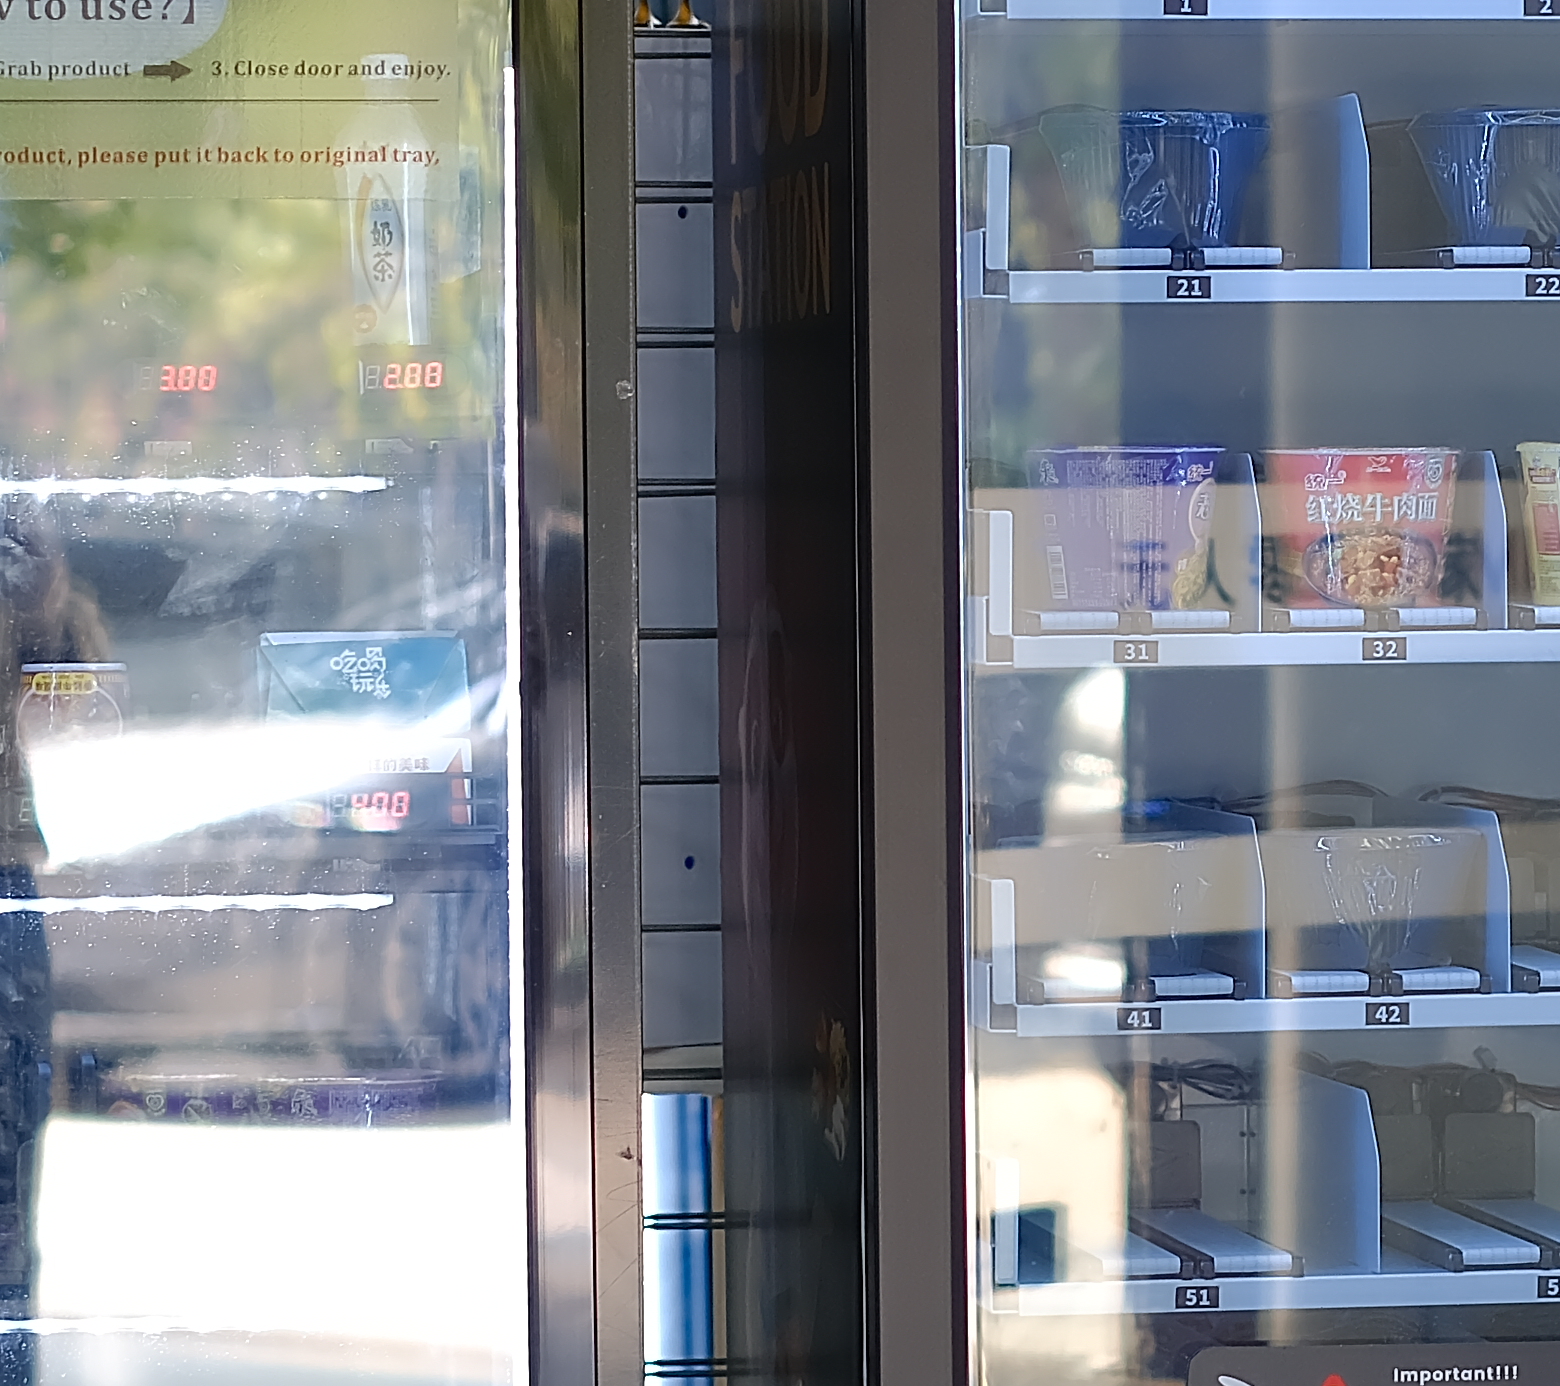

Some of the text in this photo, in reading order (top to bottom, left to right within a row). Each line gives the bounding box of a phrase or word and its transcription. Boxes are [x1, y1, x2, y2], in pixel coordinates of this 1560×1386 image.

[47, 60, 132, 83] product
[211, 59, 451, 81] 3. Close door and enjoy.
[370, 219, 396, 282] 奶茶
[1176, 277, 1202, 295] 21
[1534, 276, 1560, 293] 22
[1305, 492, 1439, 524] 红烧牛肉面
[1123, 642, 1149, 660] 31
[1371, 640, 1398, 658] 32
[1126, 1010, 1153, 1027] 41
[1374, 1005, 1401, 1023] 42
[1184, 1287, 1210, 1305] 51
[1393, 1365, 1518, 1386] Important!!!
